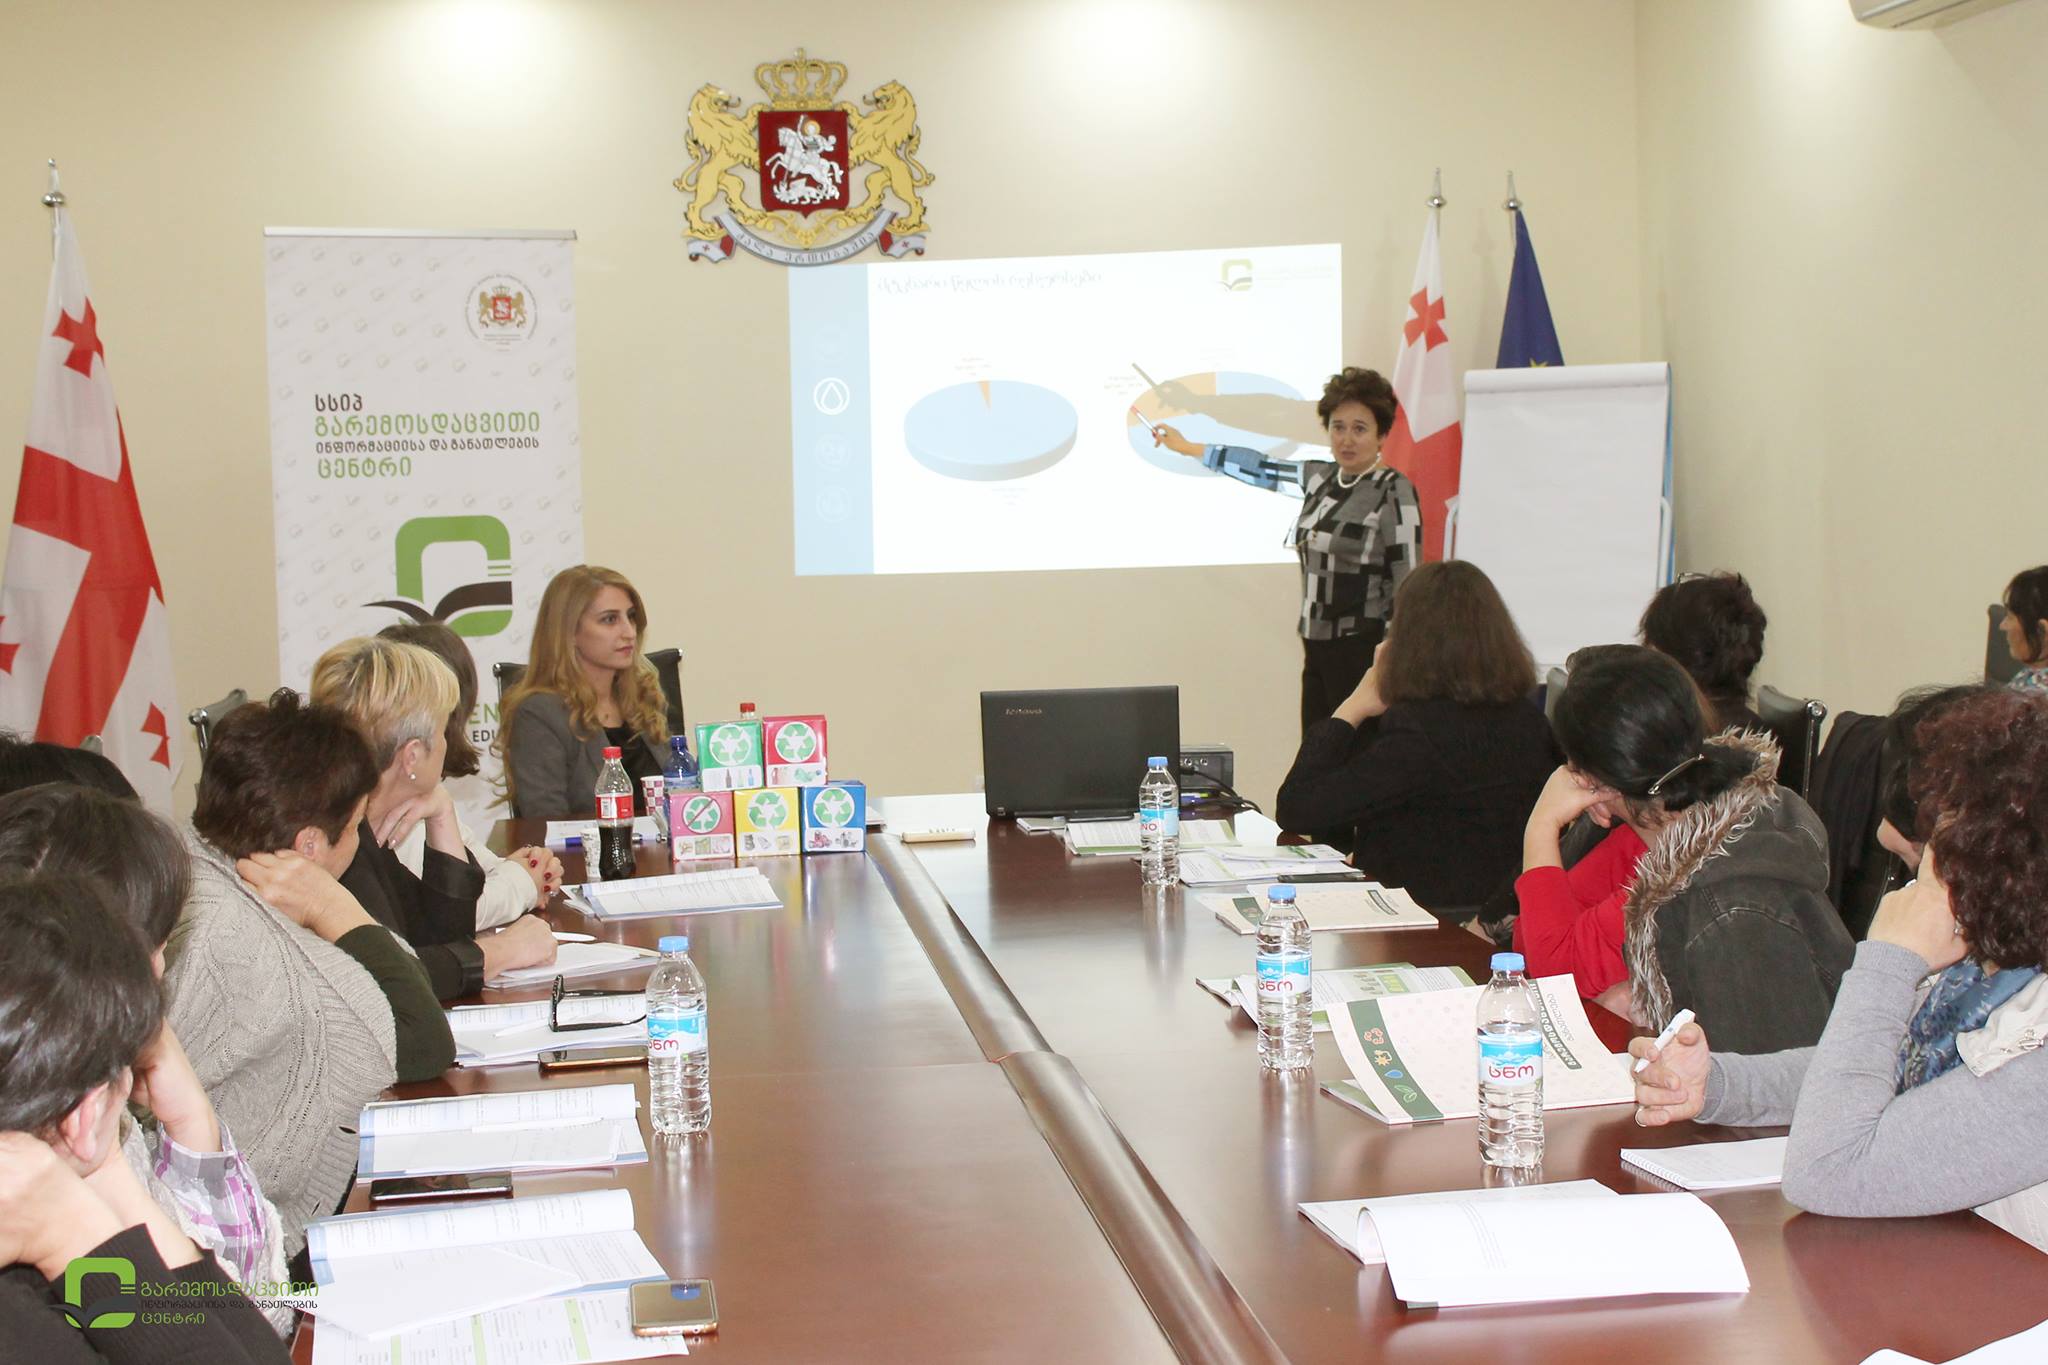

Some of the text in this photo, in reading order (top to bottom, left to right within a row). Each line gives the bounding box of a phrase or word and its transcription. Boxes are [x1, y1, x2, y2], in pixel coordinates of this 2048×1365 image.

[315, 393, 363, 412] სსიპ
[315, 411, 540, 437] გარემოსდაცვითი
[316, 437, 539, 454] ინფორმაციისა და განათლების
[318, 456, 412, 479] ცენტრი
[1488, 1065, 1534, 1079] სნო
